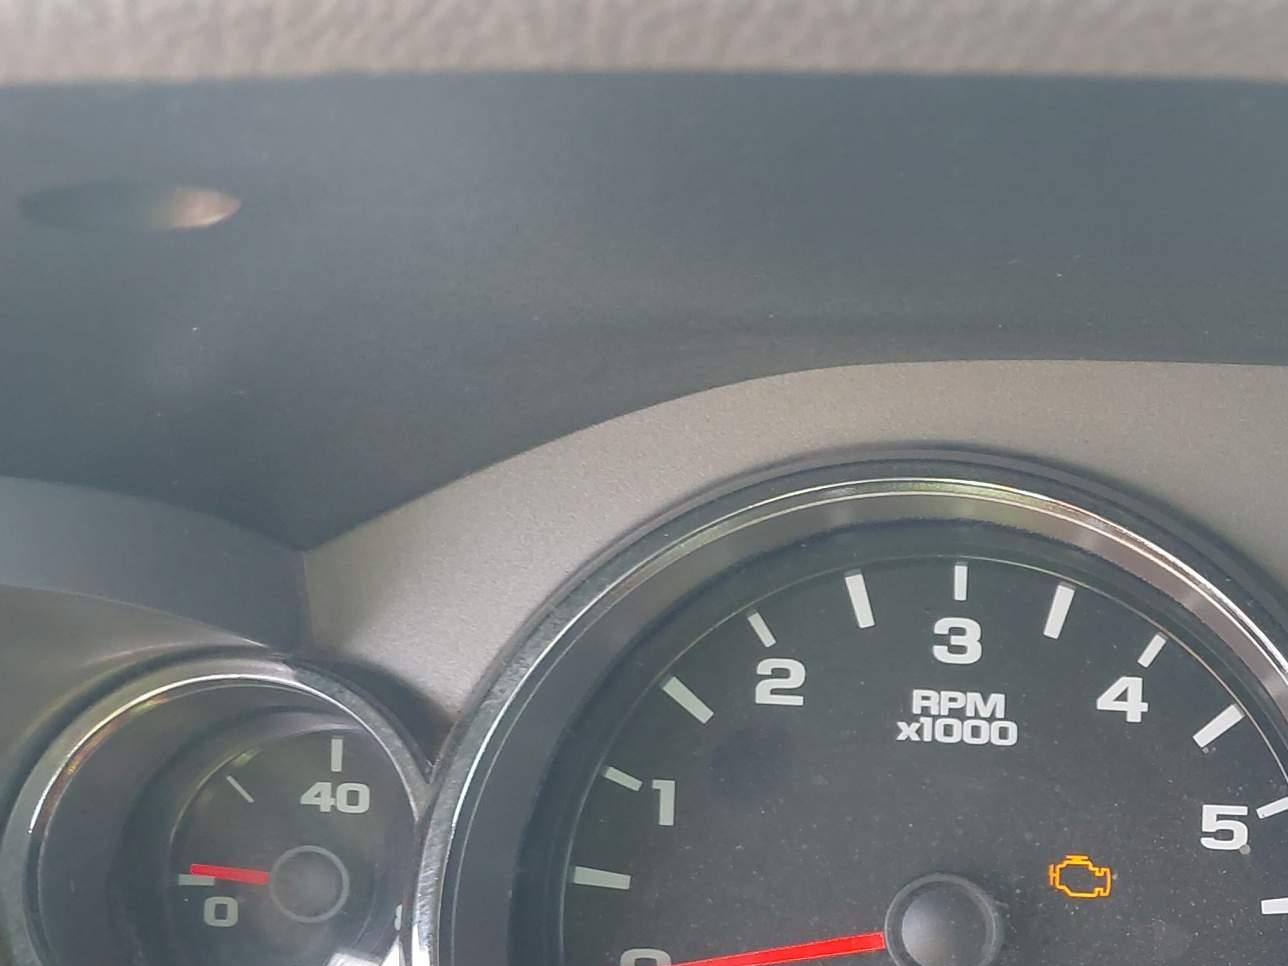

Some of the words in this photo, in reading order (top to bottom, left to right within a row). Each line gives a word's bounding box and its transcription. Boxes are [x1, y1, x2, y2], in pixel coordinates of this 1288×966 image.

[933, 618, 983, 665] 3
[755, 659, 804, 707] 2
[912, 690, 1006, 719] RPM
[1096, 677, 1148, 723] 4
[897, 720, 1018, 747] x1000
[300, 781, 370, 814] 40
[651, 780, 675, 826] 1
[1201, 806, 1248, 850] 5
[203, 897, 239, 927] 0
